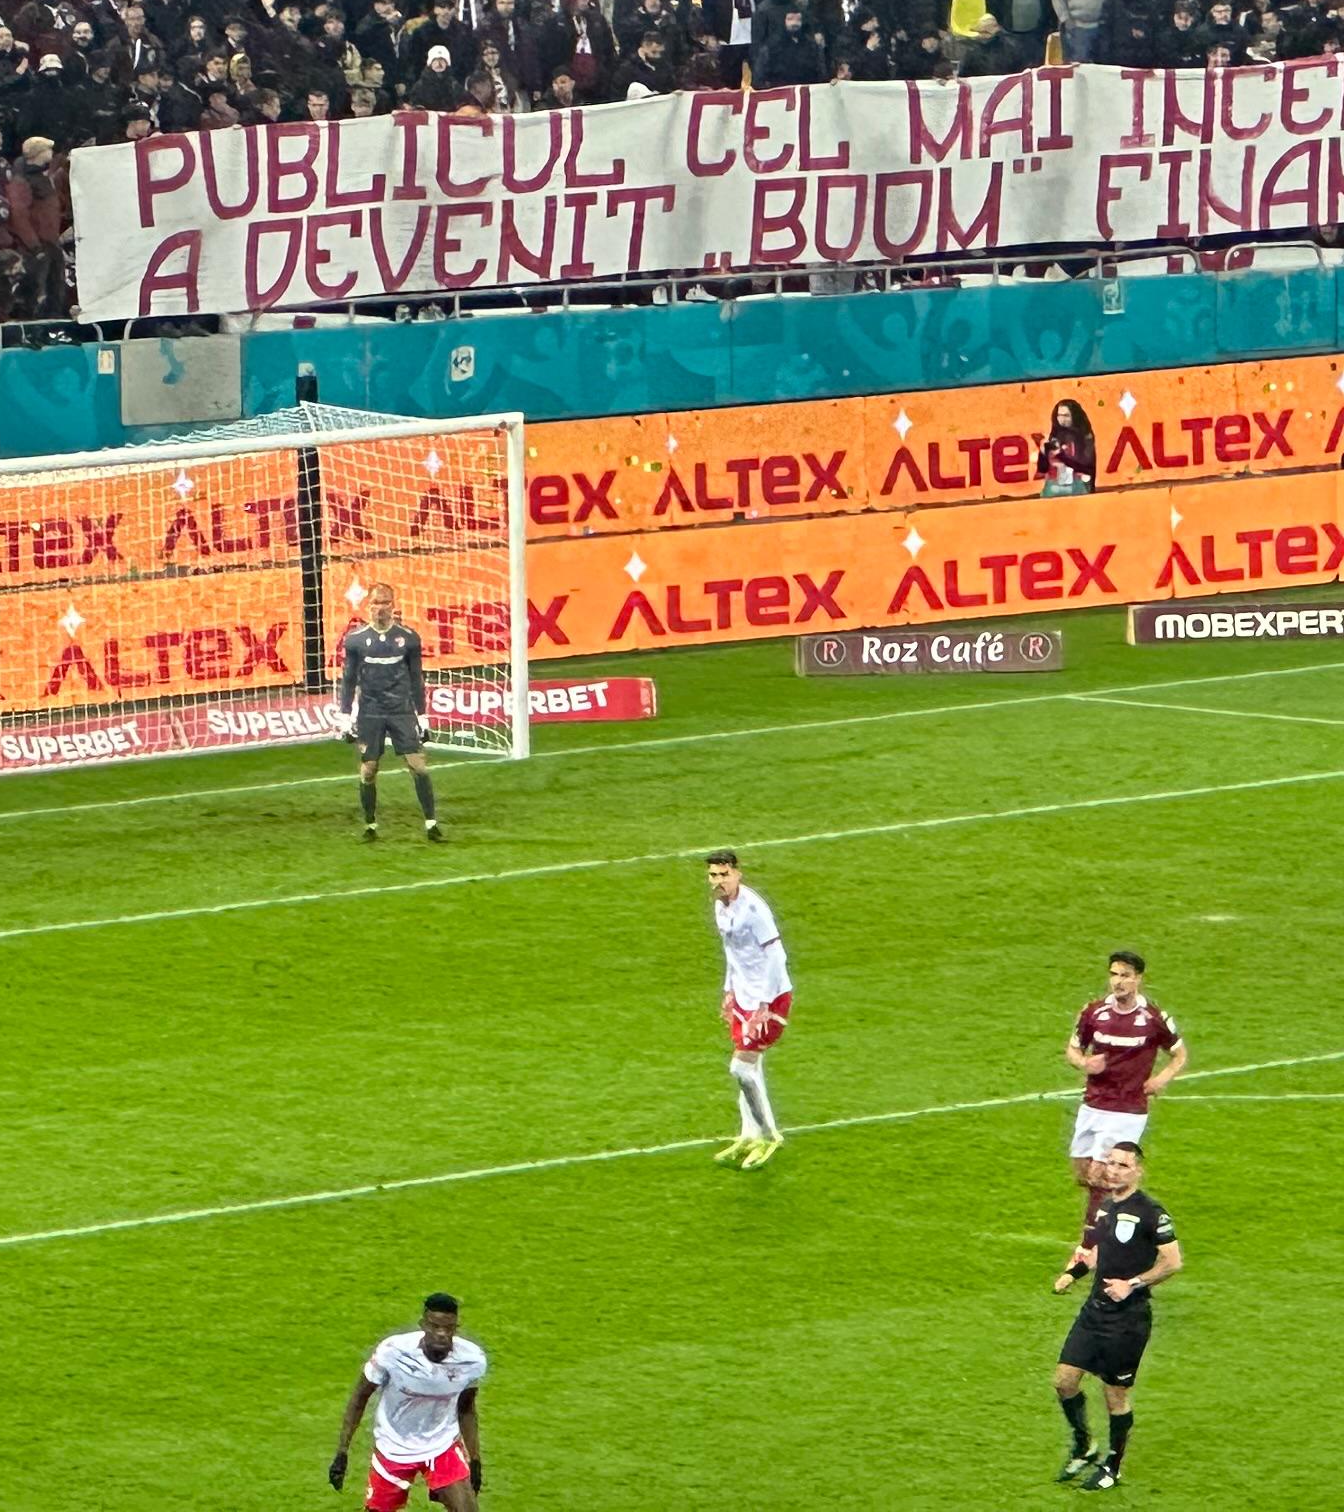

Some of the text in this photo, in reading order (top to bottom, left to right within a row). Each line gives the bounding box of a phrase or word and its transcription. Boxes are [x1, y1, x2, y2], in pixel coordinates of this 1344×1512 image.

[135, 109, 625, 228] PUBLICUL
[687, 85, 850, 178] CEL
[906, 65, 1075, 166] MAI
[138, 230, 202, 317] A
[244, 184, 676, 313] DEVENIT
[862, 635, 919, 666] Roz
[930, 631, 1005, 666] Café
[1, 721, 144, 761] SUPERBET
[208, 704, 346, 740] SUPERLIG
